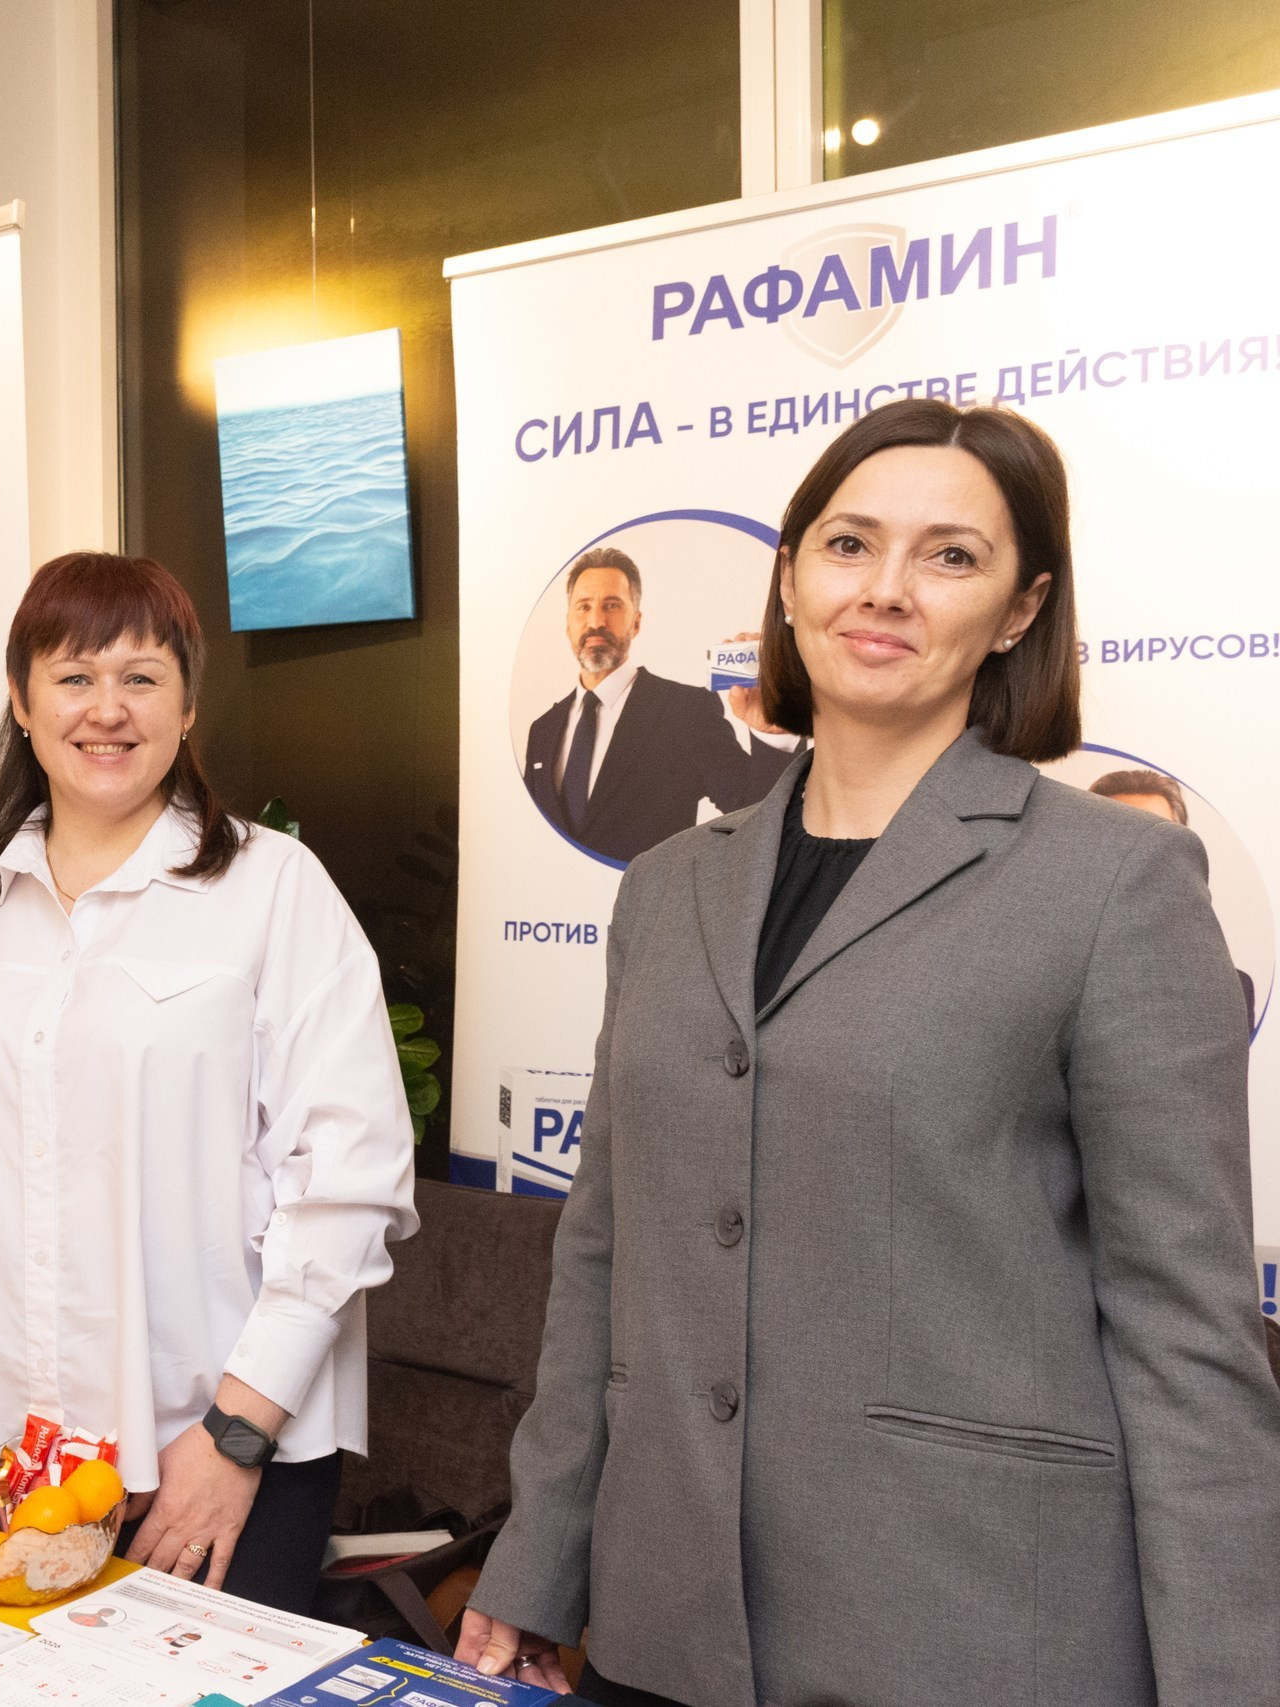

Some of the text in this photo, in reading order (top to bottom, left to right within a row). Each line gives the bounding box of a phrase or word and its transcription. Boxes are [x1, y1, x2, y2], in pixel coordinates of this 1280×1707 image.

[651, 214, 1058, 341] РАФАМИН
[515, 401, 663, 465] СИЛА
[710, 405, 732, 440] В
[1101, 633, 1280, 664] ВИРУСОВ!
[504, 921, 598, 945] ПРОТИВ
